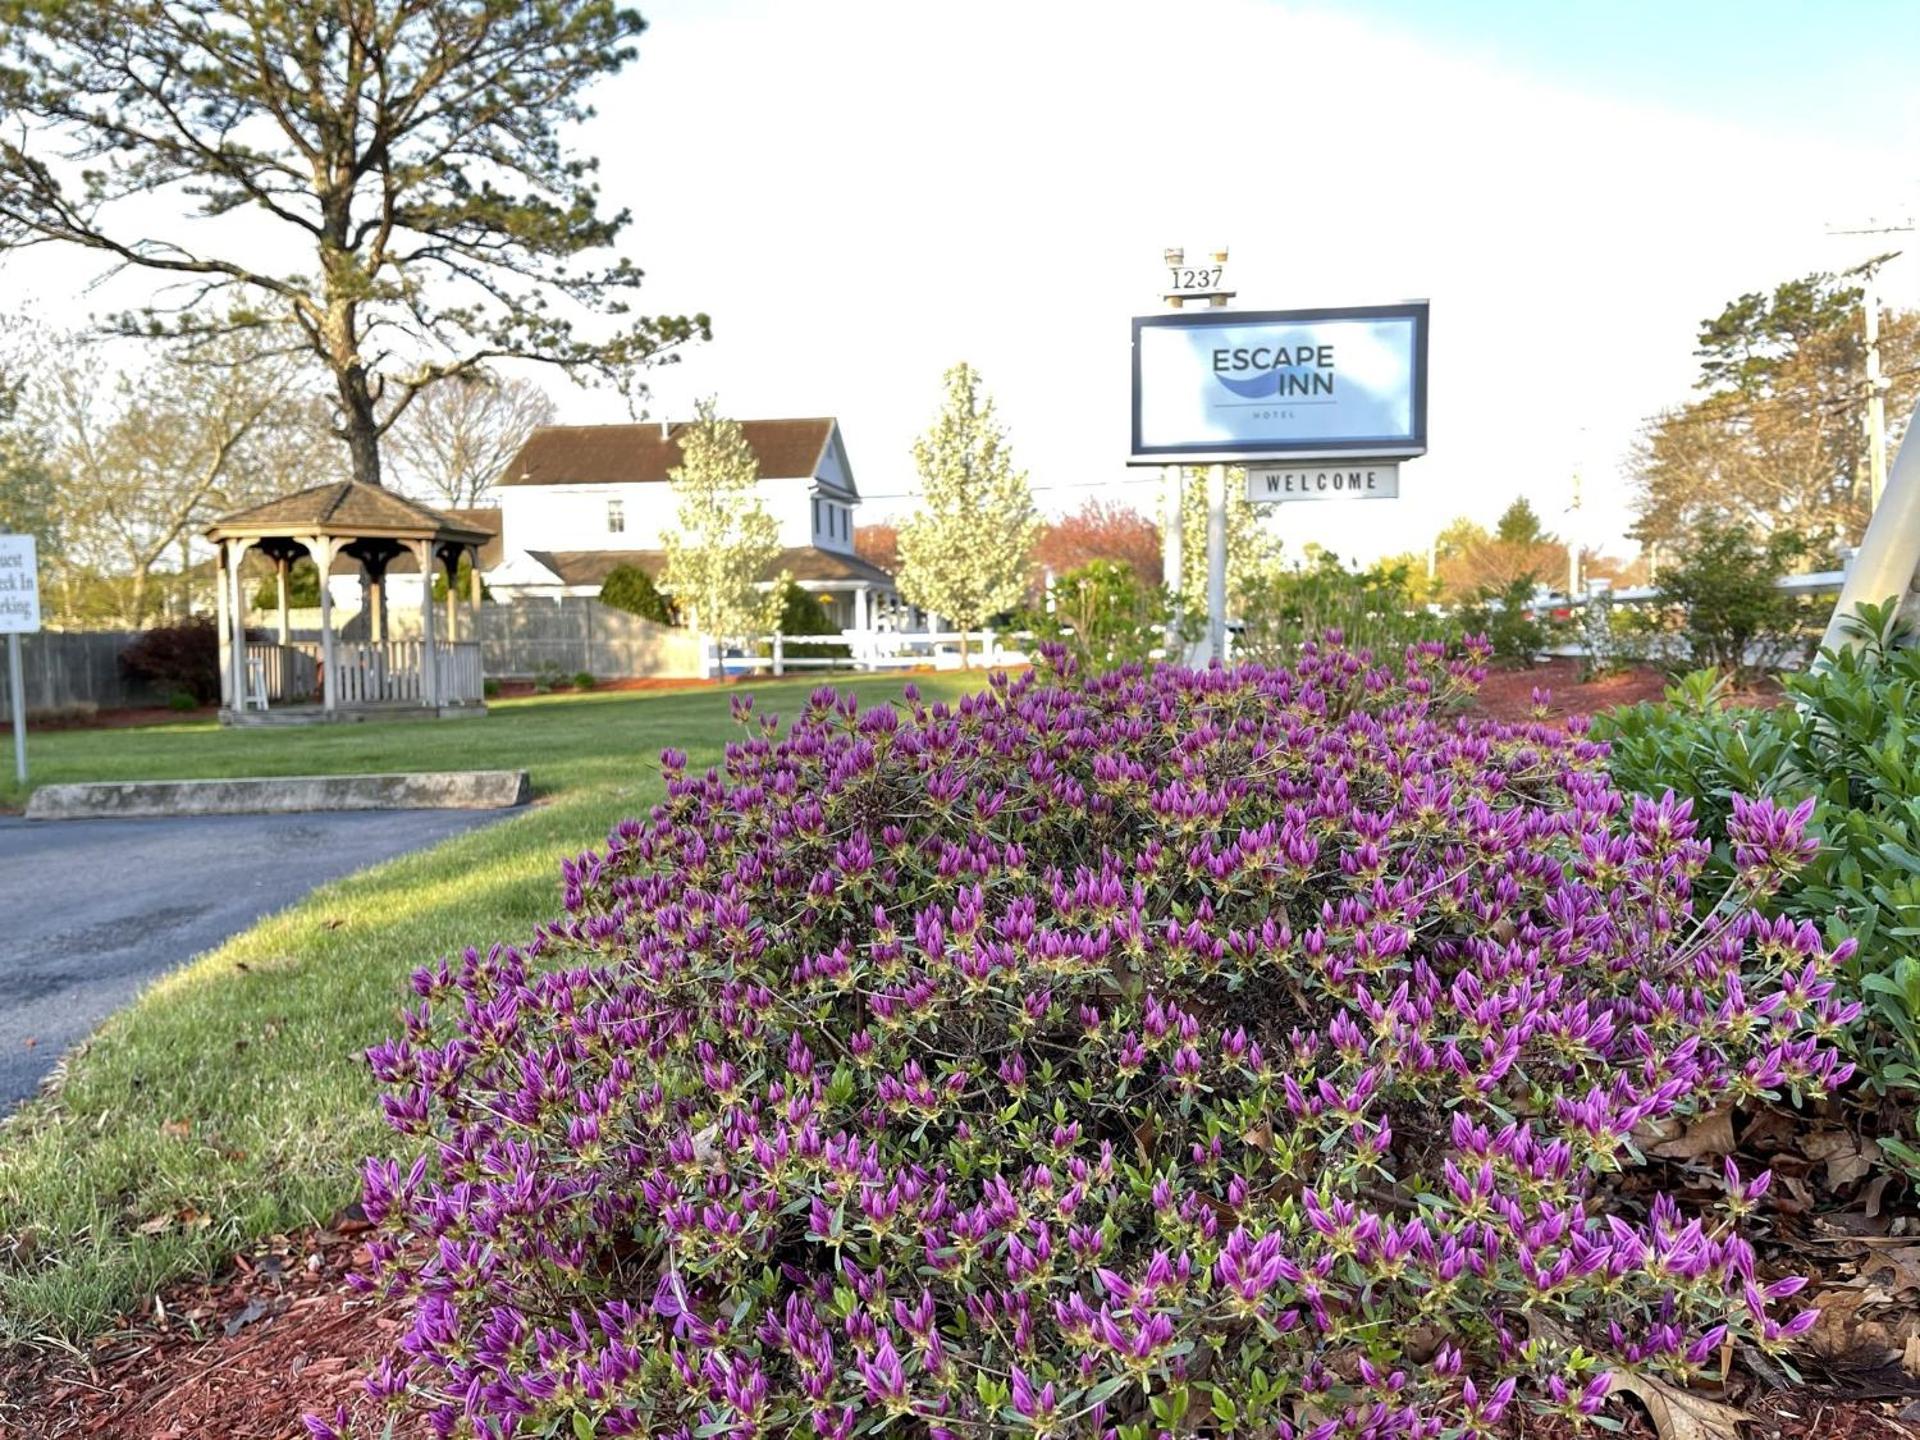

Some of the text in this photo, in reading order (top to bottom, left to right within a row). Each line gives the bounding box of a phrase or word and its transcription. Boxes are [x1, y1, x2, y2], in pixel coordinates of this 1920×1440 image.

[1173, 268, 1222, 288] 1237
[1213, 345, 1334, 371] ESCAPE
[1279, 372, 1333, 396] INN
[1252, 410, 1295, 420] HOTEL
[1266, 472, 1376, 492] WELCOME
[20, 573, 33, 591] In
